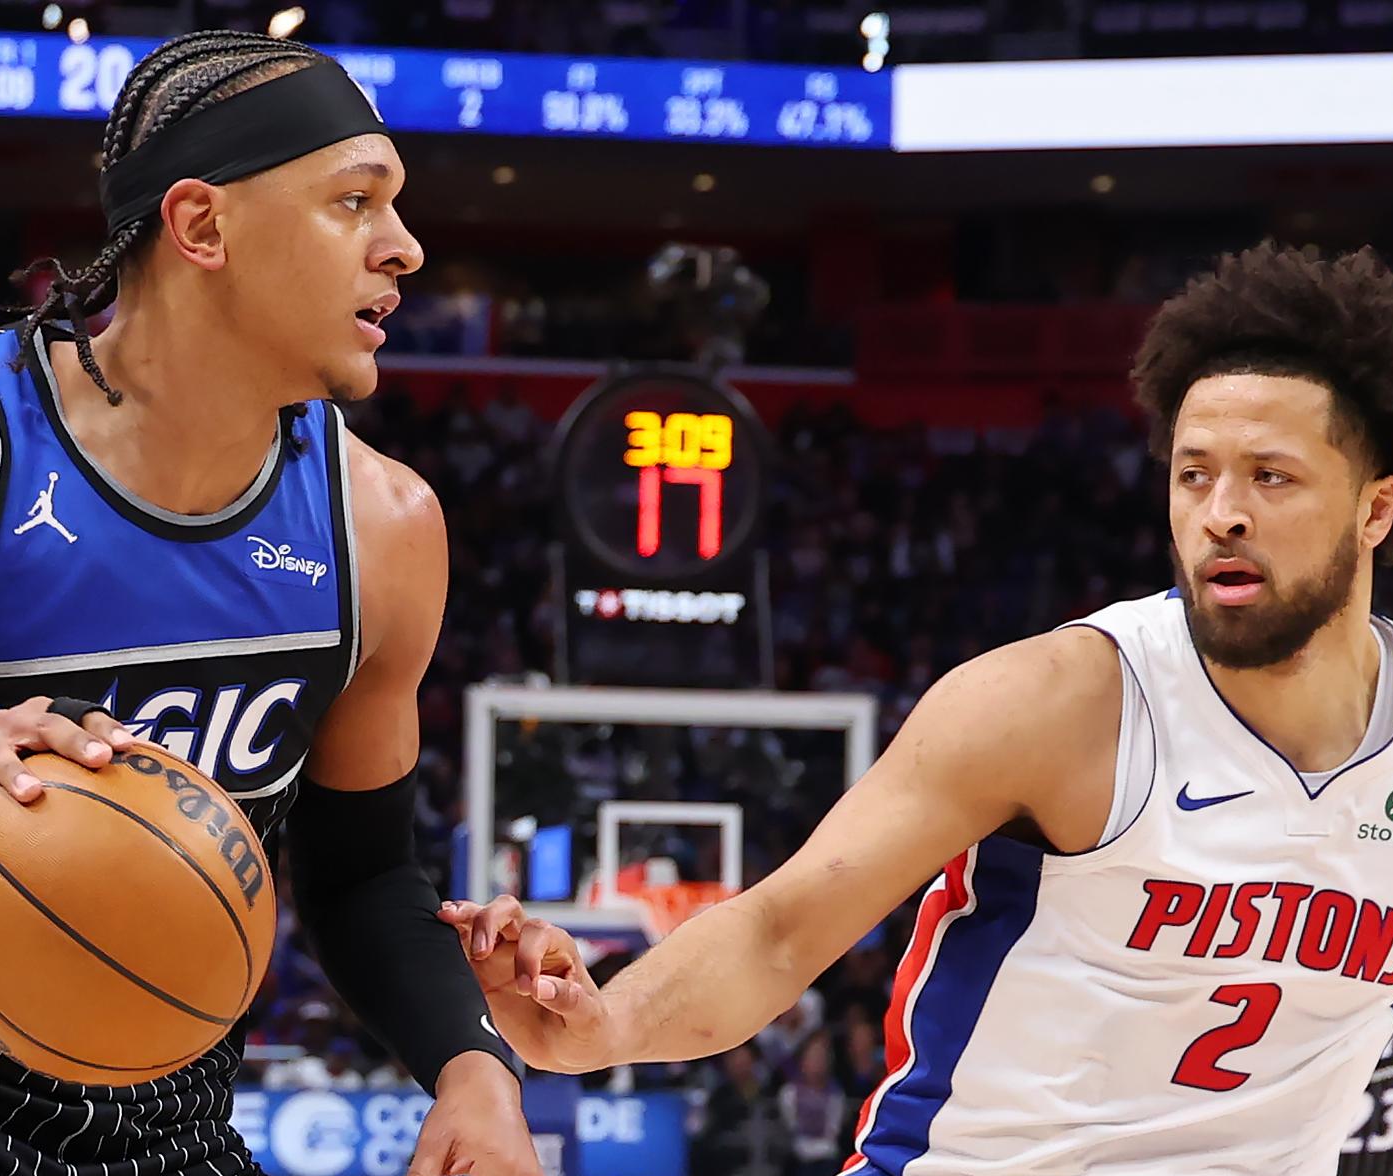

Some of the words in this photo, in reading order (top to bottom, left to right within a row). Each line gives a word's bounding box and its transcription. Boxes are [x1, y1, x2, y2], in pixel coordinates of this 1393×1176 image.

[59, 44, 134, 112] 20
[636, 466, 725, 560] 17
[247, 536, 327, 586] Disney
[109, 752, 264, 912] Wilso
[1170, 982, 1283, 1092] 2
